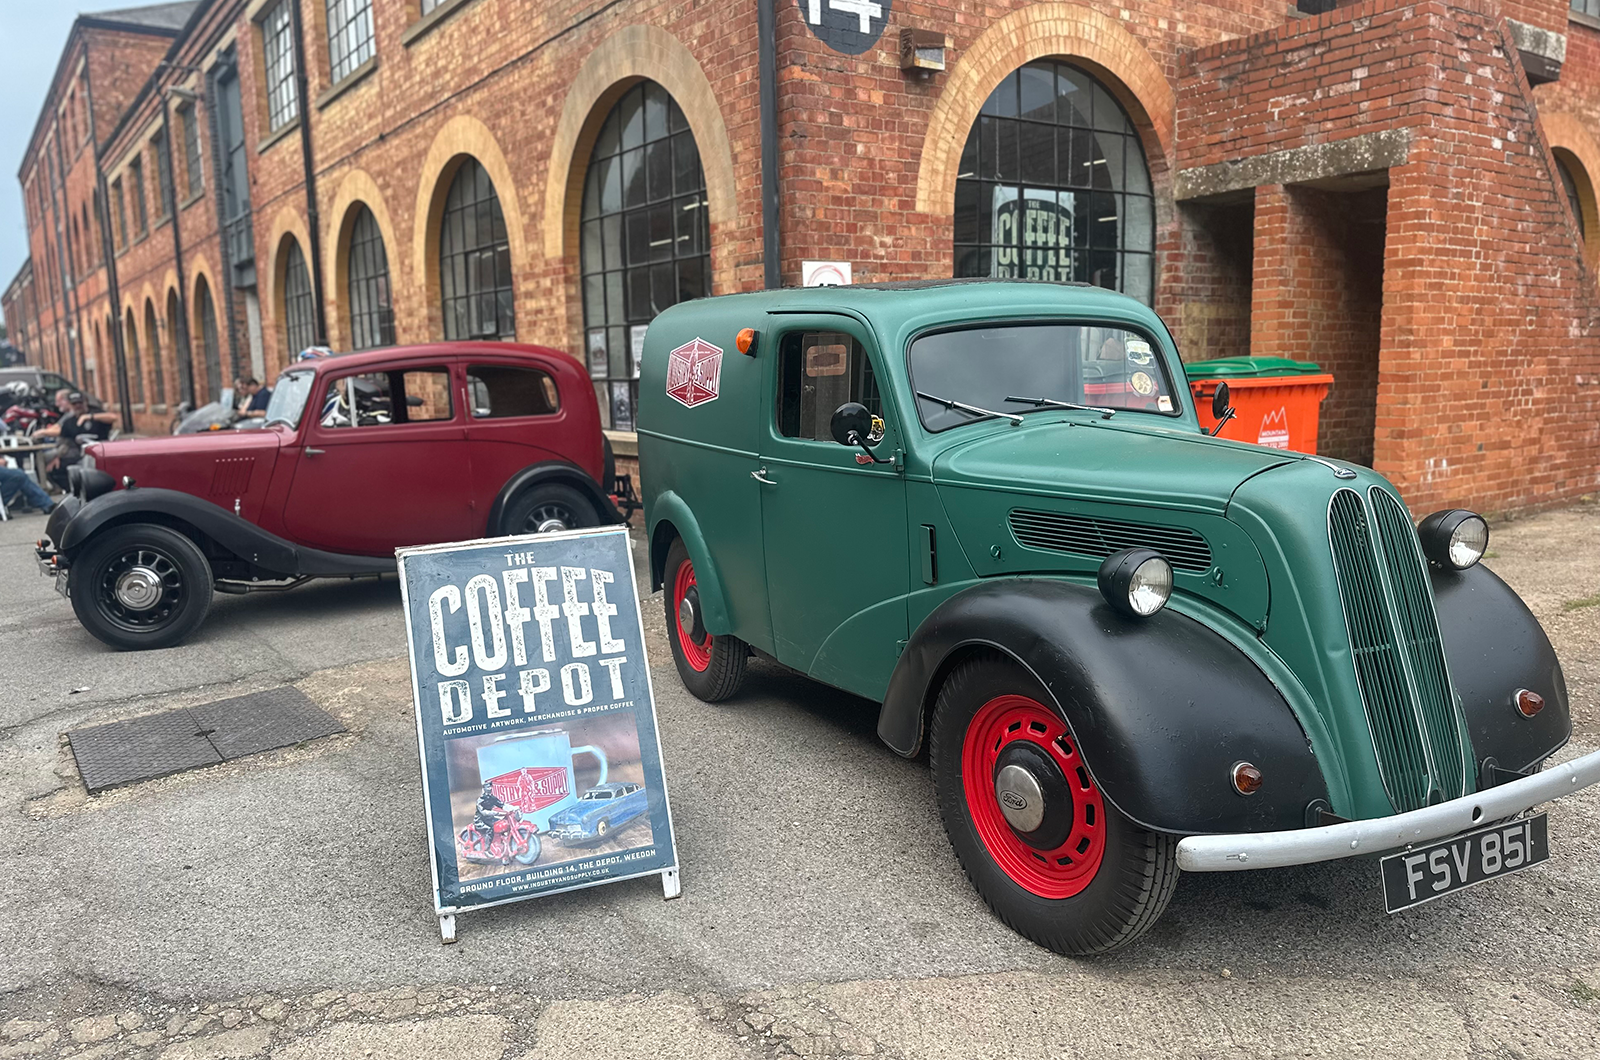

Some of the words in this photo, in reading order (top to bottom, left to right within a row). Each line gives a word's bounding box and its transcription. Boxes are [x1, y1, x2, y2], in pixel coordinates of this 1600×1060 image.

[1027, 200, 1041, 209] THE
[504, 551, 536, 566] THE
[428, 566, 626, 677] COFFEE
[437, 656, 628, 726] DEPOT
[442, 723, 488, 736] AUTOMOTIVE
[490, 717, 527, 728] ARTWORK,
[528, 709, 576, 721] MERCHANDISE
[583, 704, 609, 714] PROPER
[609, 700, 635, 709] COFFEE
[541, 769, 568, 796] SUPPLY
[1003, 792, 1024, 807] Ford
[460, 881, 494, 894] GROUND
[496, 875, 525, 887] FLOOR,
[526, 866, 563, 880] BUILDING
[565, 864, 577, 873] 14,
[579, 860, 594, 870] THE
[596, 855, 623, 867] DEPOT,
[624, 849, 656, 861] WEEDON
[1405, 840, 1471, 900] FSV
[1480, 824, 1532, 875] 851
